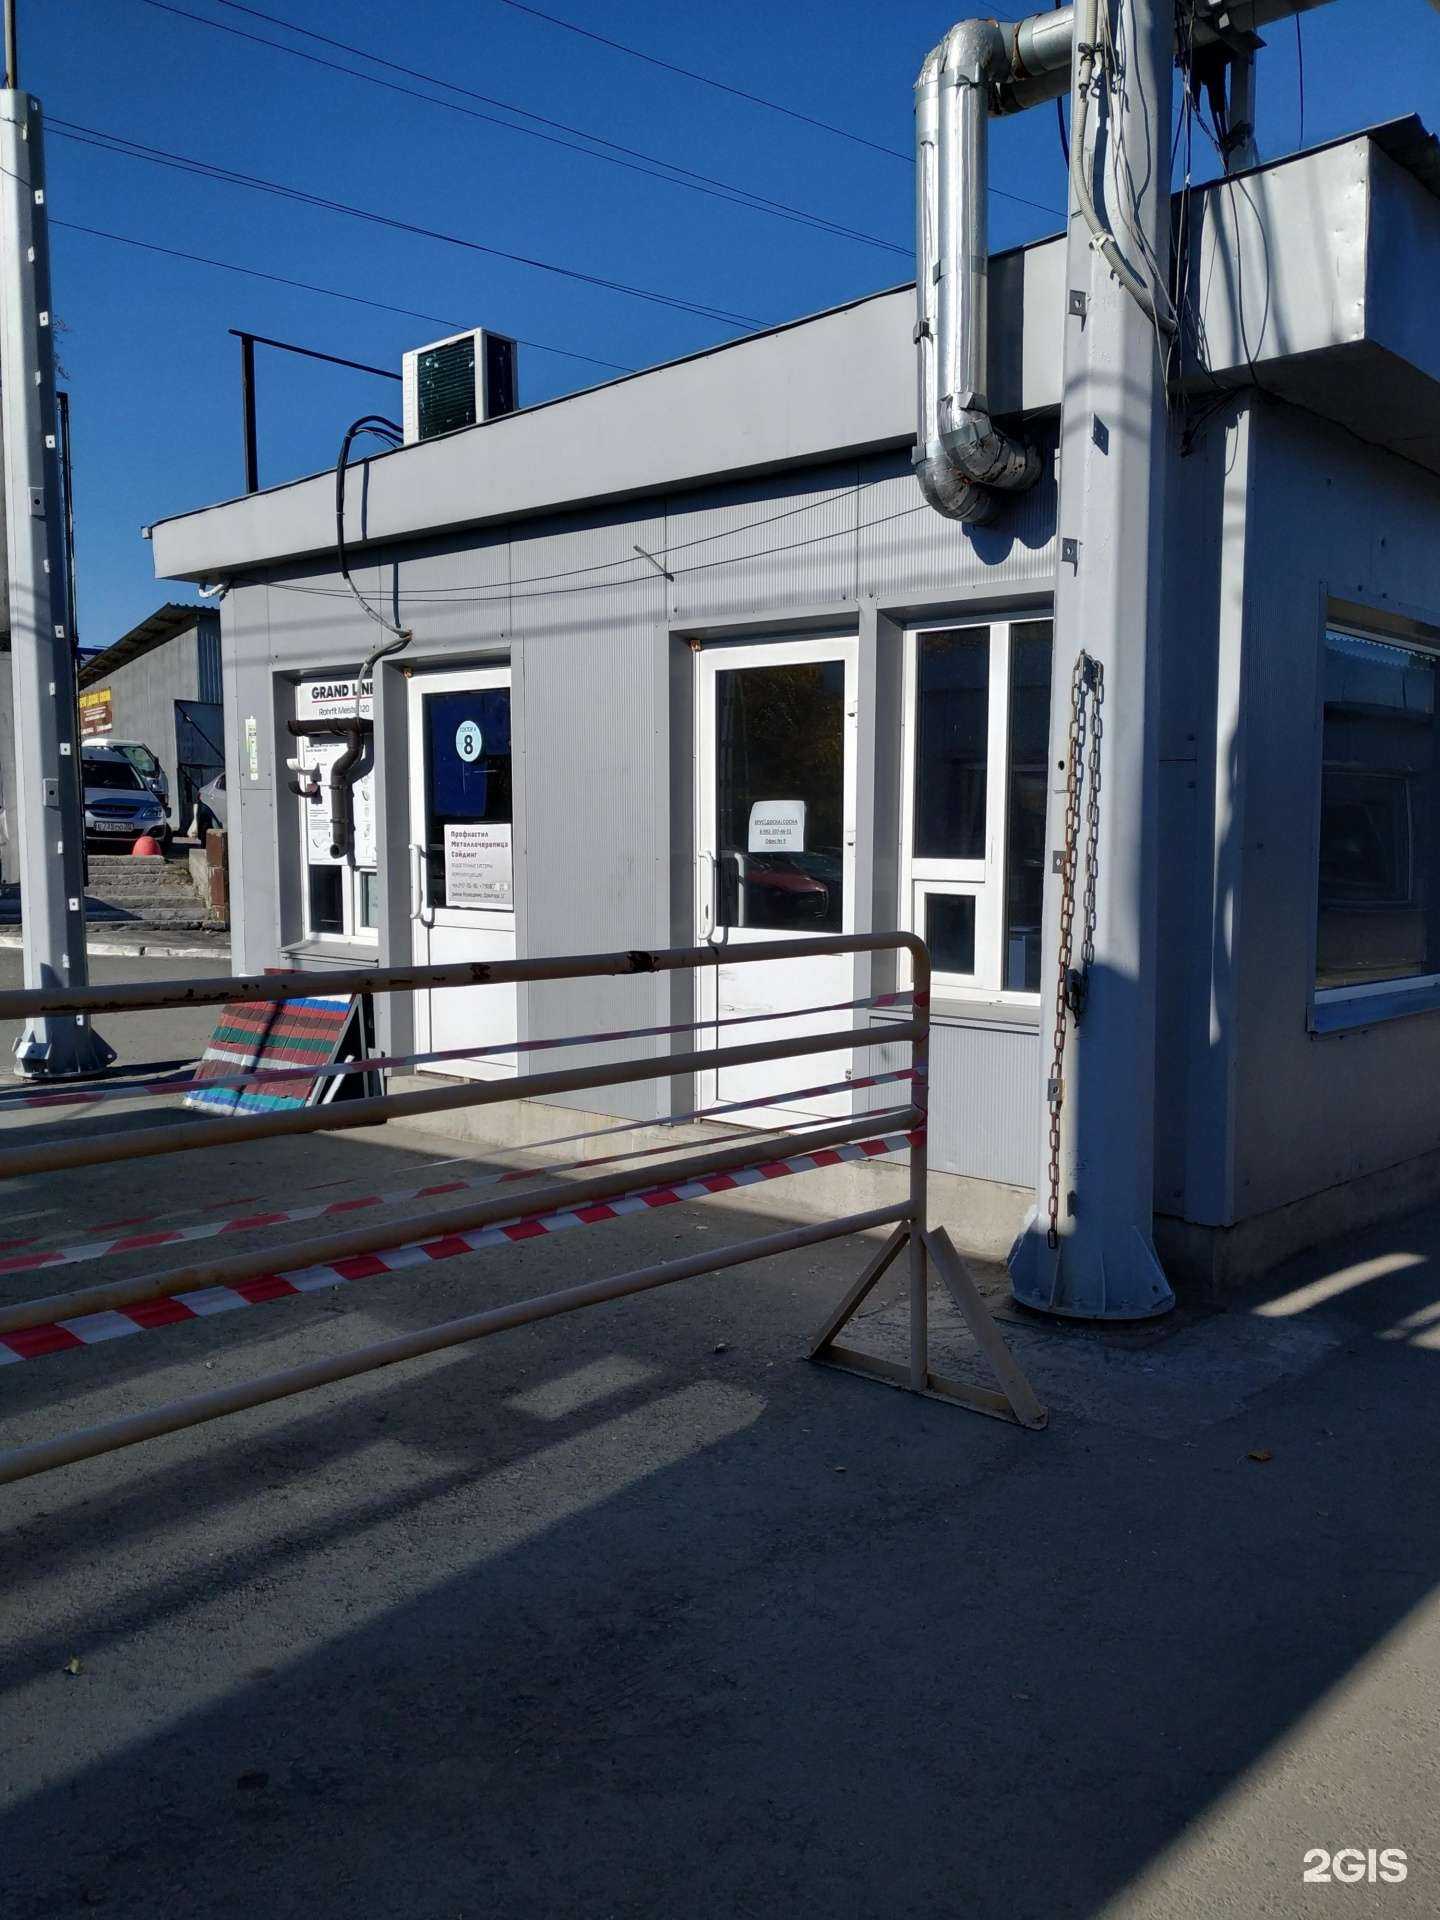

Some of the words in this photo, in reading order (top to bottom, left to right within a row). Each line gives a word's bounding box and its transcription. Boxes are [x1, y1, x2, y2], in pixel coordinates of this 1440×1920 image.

[312, 684, 349, 699] GRAND
[464, 735, 474, 755] 8
[451, 841, 509, 849] Металлочерепица
[451, 850, 477, 858] Сайдинг
